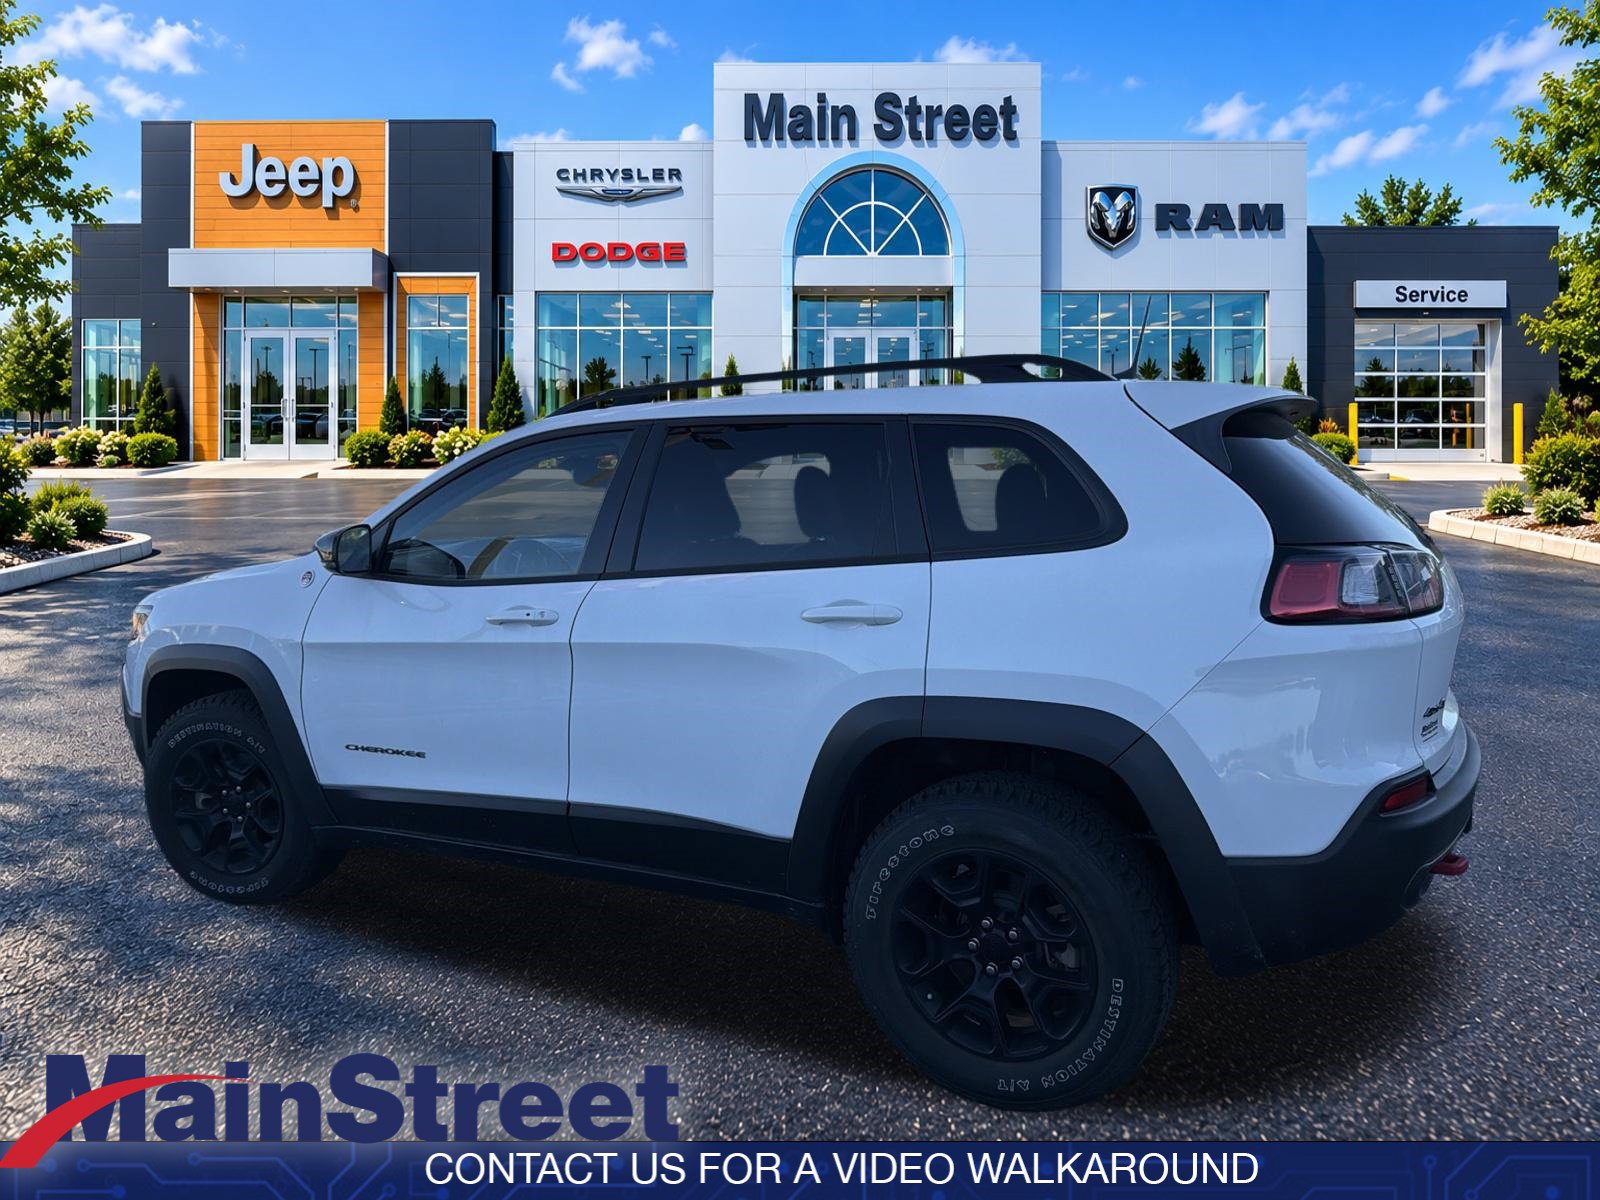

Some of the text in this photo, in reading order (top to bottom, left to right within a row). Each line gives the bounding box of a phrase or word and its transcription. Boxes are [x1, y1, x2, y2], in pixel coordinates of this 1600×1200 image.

[744, 91, 1017, 141] Main Street
[218, 143, 355, 208] Jeep
[556, 168, 682, 181] CHRYSLER
[1155, 203, 1284, 231] RAM
[551, 242, 687, 261] DODGE
[1395, 285, 1469, 303] Service
[345, 744, 426, 759] CHEROKEE
[1041, 978, 1123, 1088] DESTINATION
